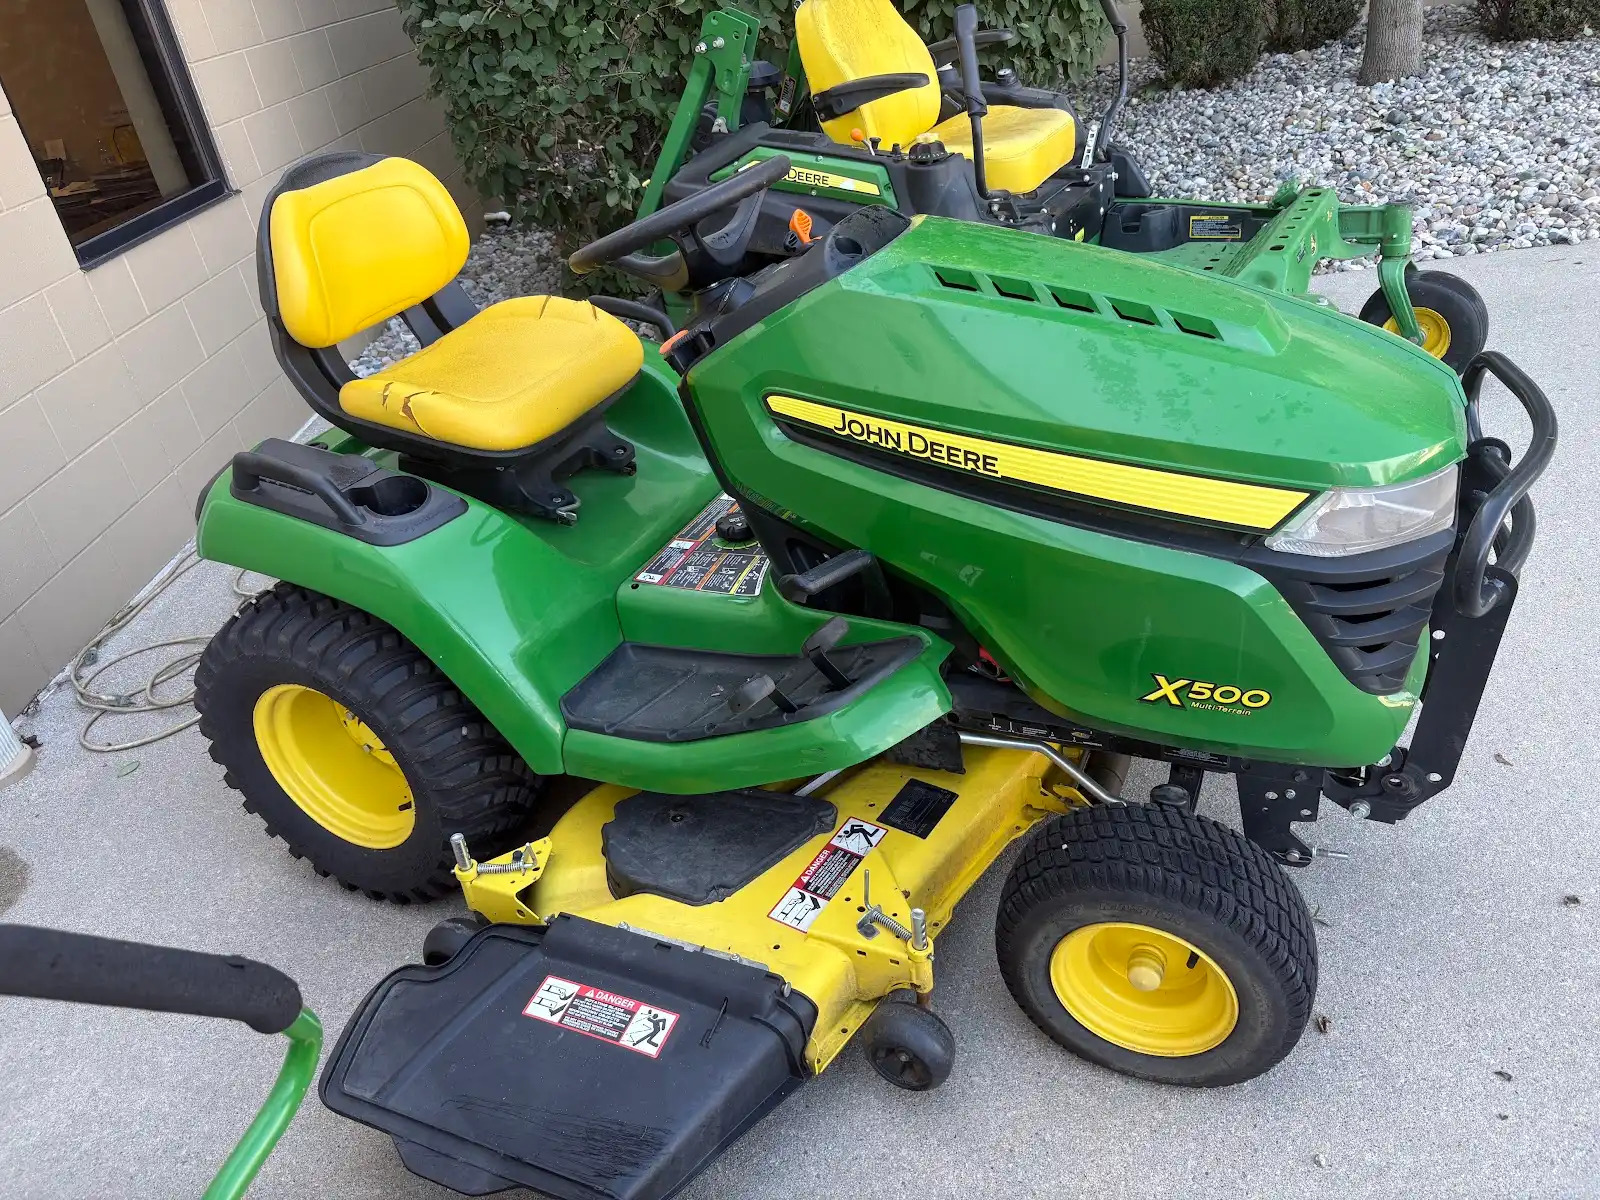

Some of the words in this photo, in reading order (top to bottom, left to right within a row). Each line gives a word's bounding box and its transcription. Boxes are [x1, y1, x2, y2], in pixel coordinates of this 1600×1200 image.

[787, 168, 830, 186] DEERE
[833, 412, 902, 450] JOHN
[907, 431, 999, 475] DEERE
[1139, 673, 1272, 710] X500
[1190, 701, 1252, 716] Multi-Terrain
[804, 849, 831, 876] DANGER
[595, 991, 636, 1010] DANGER
